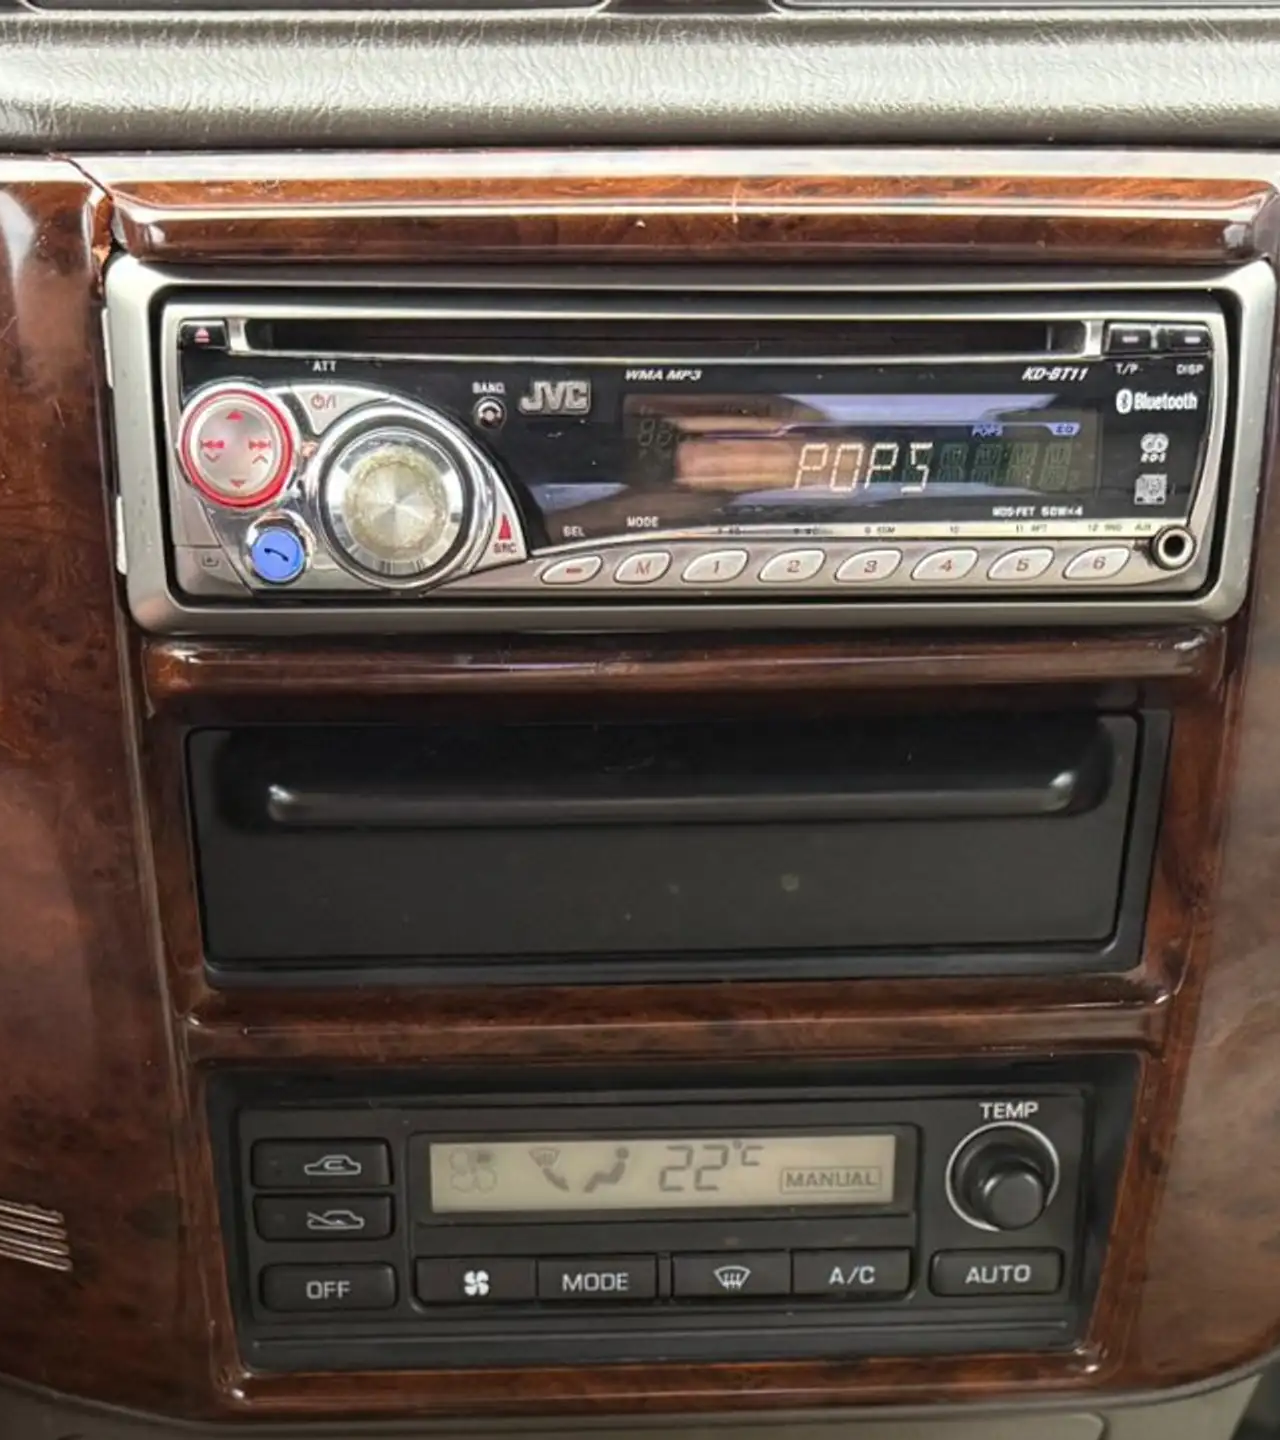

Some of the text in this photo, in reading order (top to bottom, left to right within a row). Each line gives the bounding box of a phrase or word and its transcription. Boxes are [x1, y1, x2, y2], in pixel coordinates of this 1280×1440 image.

[312, 361, 337, 372] ATT
[625, 369, 703, 381] WMA MP3
[1022, 367, 1089, 381] KD-BT11
[520, 381, 589, 412] JVC
[1134, 391, 1198, 411] Bluetooth
[794, 442, 934, 493] POPS
[627, 516, 659, 527] MODE
[562, 526, 585, 538] SEL
[635, 560, 653, 575] M
[787, 560, 800, 573] 2
[864, 560, 877, 573] 3
[939, 559, 952, 572] 4
[1016, 557, 1029, 571] 5
[1093, 556, 1106, 570] 6
[979, 1101, 1039, 1119] TEMP
[785, 1171, 878, 1189] MANUAL
[829, 1265, 877, 1285] A/C
[965, 1264, 1032, 1285] AUTO
[562, 1272, 630, 1292] MODE
[306, 1280, 351, 1300] OFF
